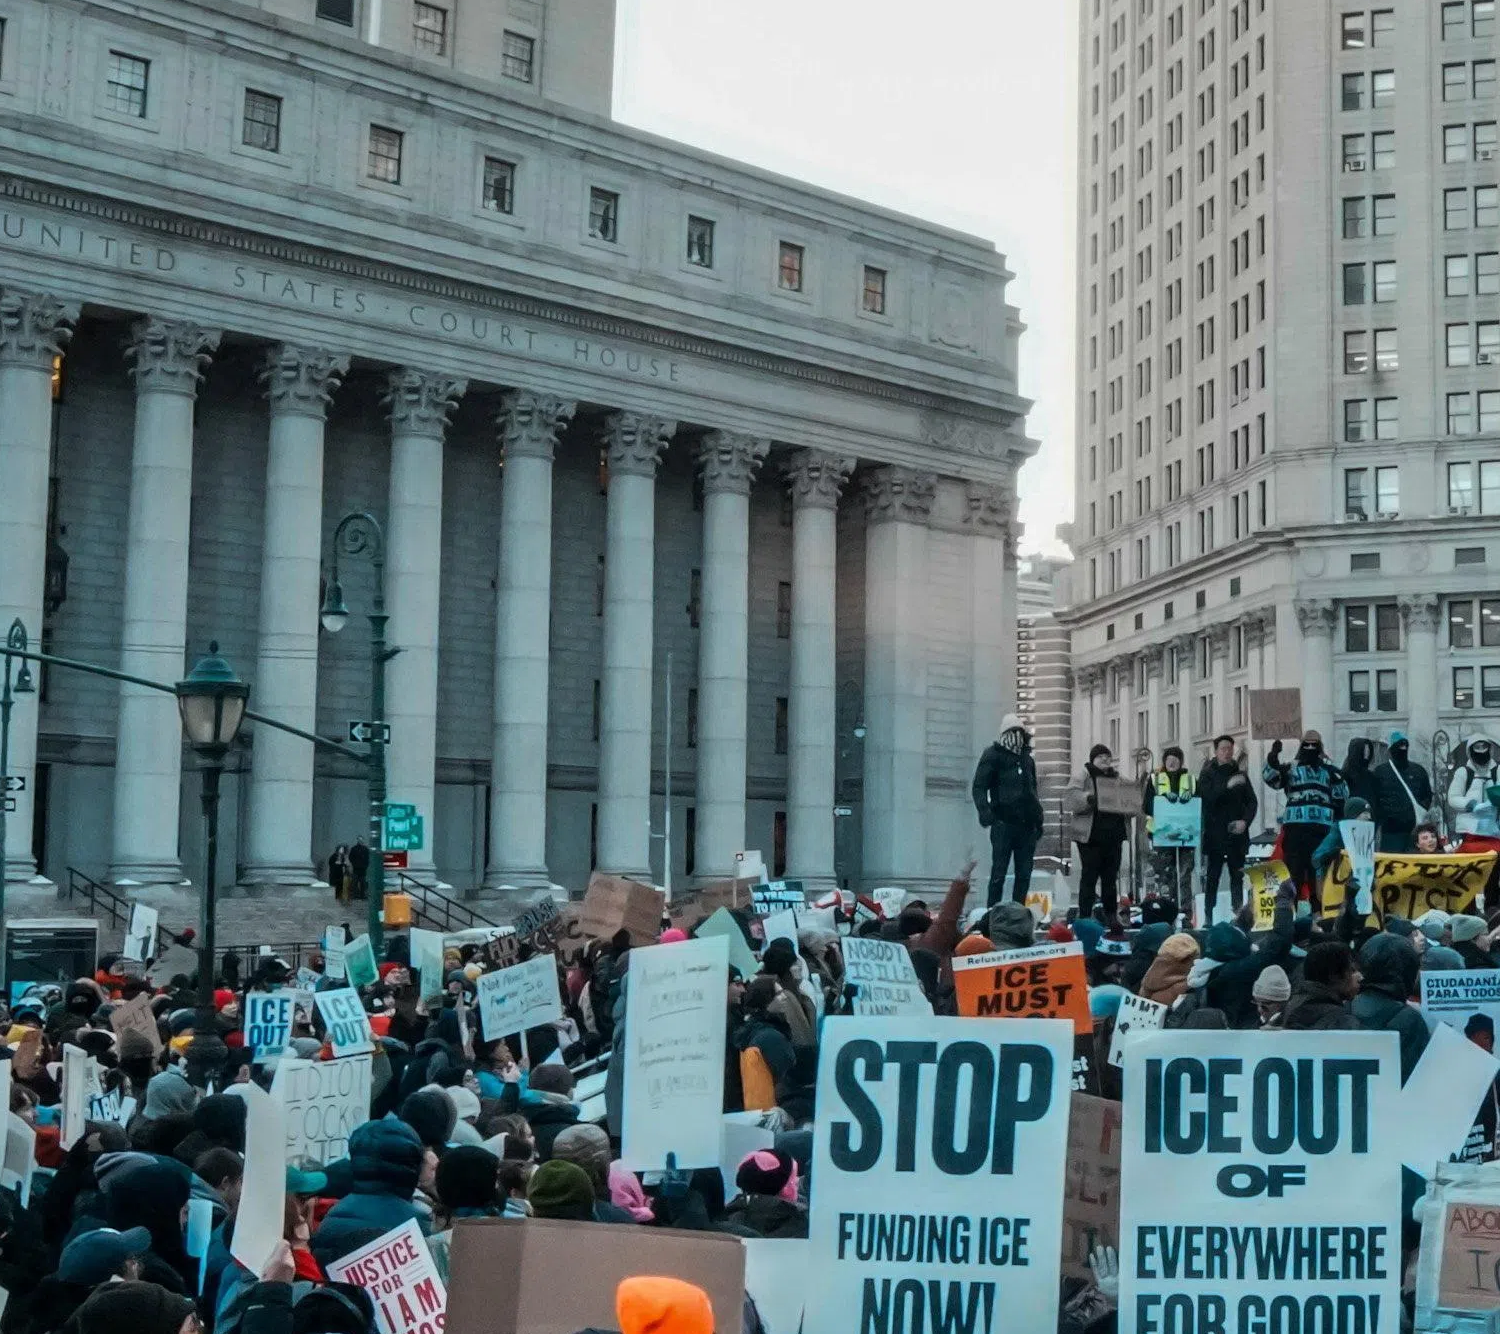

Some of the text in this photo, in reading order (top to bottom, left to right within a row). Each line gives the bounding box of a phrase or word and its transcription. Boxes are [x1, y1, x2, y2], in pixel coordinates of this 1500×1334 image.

[2, 213, 680, 382] UNITED STATES COURT HOUSE
[848, 940, 901, 963] NOBODY
[967, 946, 1067, 967] RefuseFascism.org
[993, 963, 1049, 990] ICE
[321, 994, 363, 1020] ICE
[976, 984, 1073, 1017] MUST
[1427, 988, 1460, 999] PARA
[250, 998, 290, 1024] ICE
[248, 1024, 288, 1049] OUT
[333, 1019, 369, 1047] OUT
[286, 1058, 369, 1103] IDIOT
[829, 1038, 1053, 1175] STOP
[1145, 1057, 1242, 1155] ICE
[1253, 1057, 1380, 1155] OUT
[1217, 1164, 1306, 1198] OF
[838, 1213, 1030, 1266] FUNDING ICE
[1136, 1226, 1387, 1281] EVERYWHERE
[344, 1234, 421, 1289] JUSTICE
[371, 1273, 404, 1301] FOR
[380, 1277, 442, 1334] IAM
